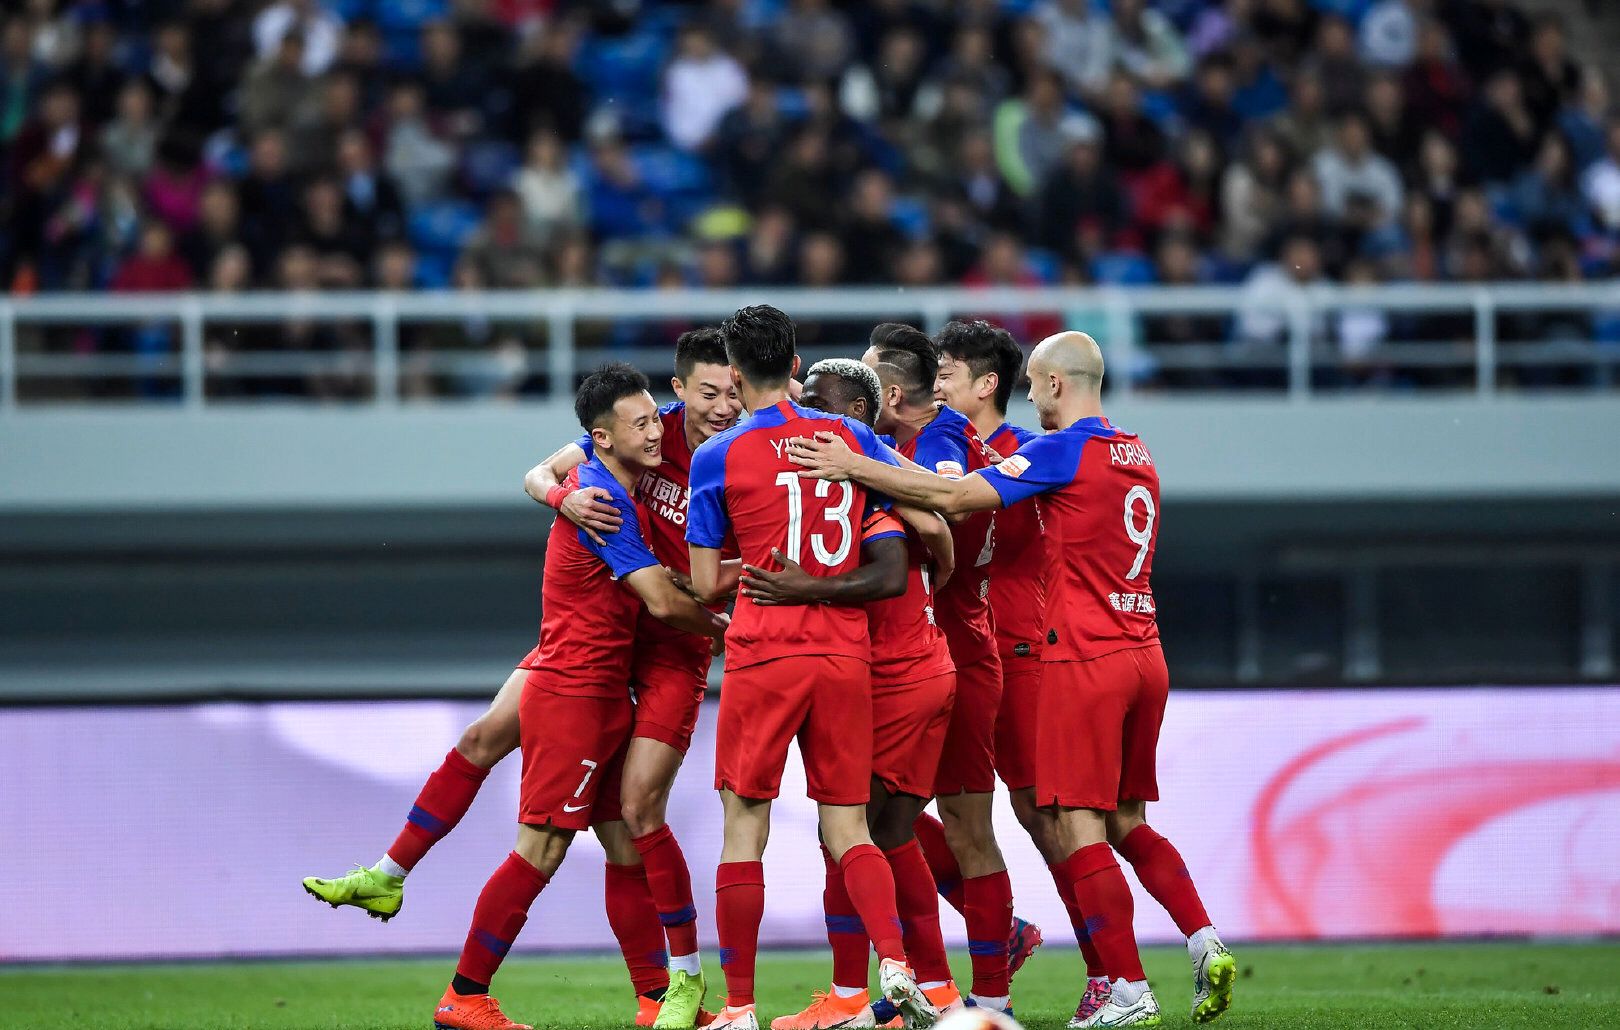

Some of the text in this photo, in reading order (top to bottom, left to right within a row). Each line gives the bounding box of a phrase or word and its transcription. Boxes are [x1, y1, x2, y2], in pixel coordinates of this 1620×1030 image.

[775, 471, 853, 567] 13
[1123, 484, 1156, 580] 9
[573, 759, 598, 798] 7
